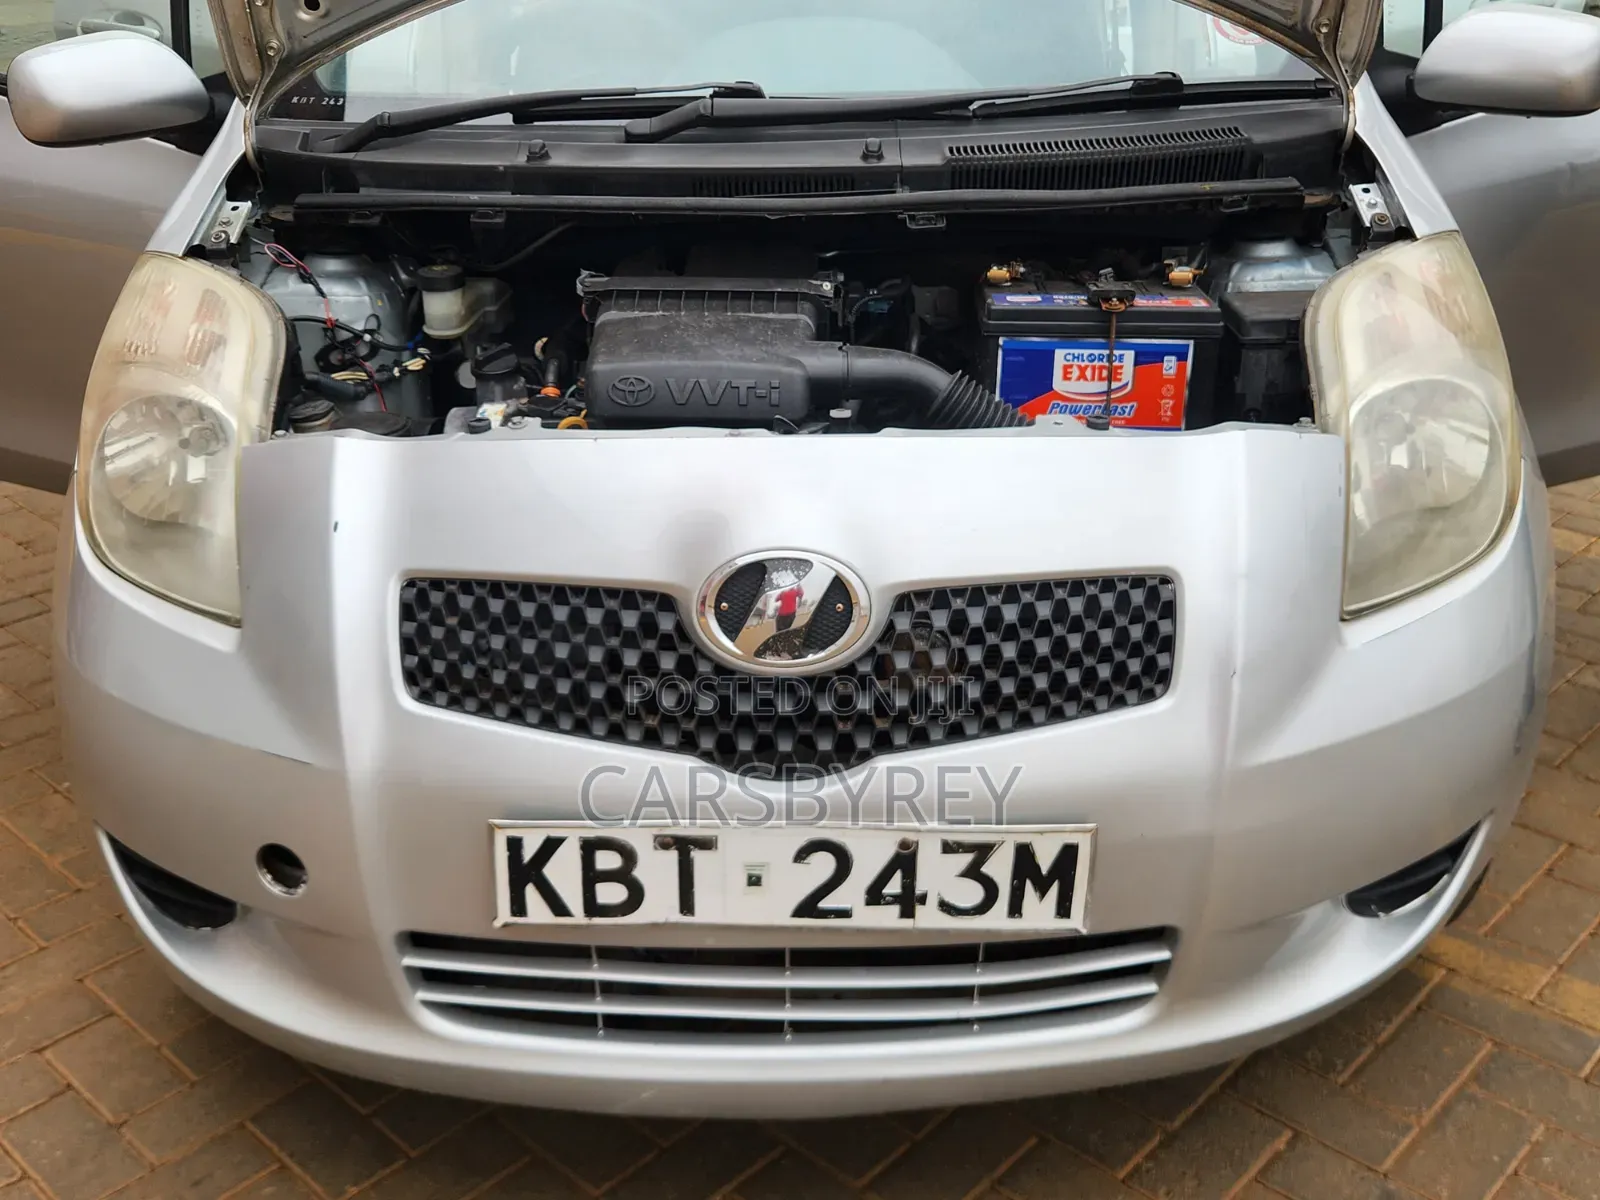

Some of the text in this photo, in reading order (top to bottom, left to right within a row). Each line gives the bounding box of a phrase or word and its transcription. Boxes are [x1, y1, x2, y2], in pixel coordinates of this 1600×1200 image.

[1063, 352, 1125, 363] CHLORIDE
[1062, 364, 1124, 382] EXIDE
[665, 378, 781, 406] VVT-i
[506, 834, 1080, 919] KBT 243M
